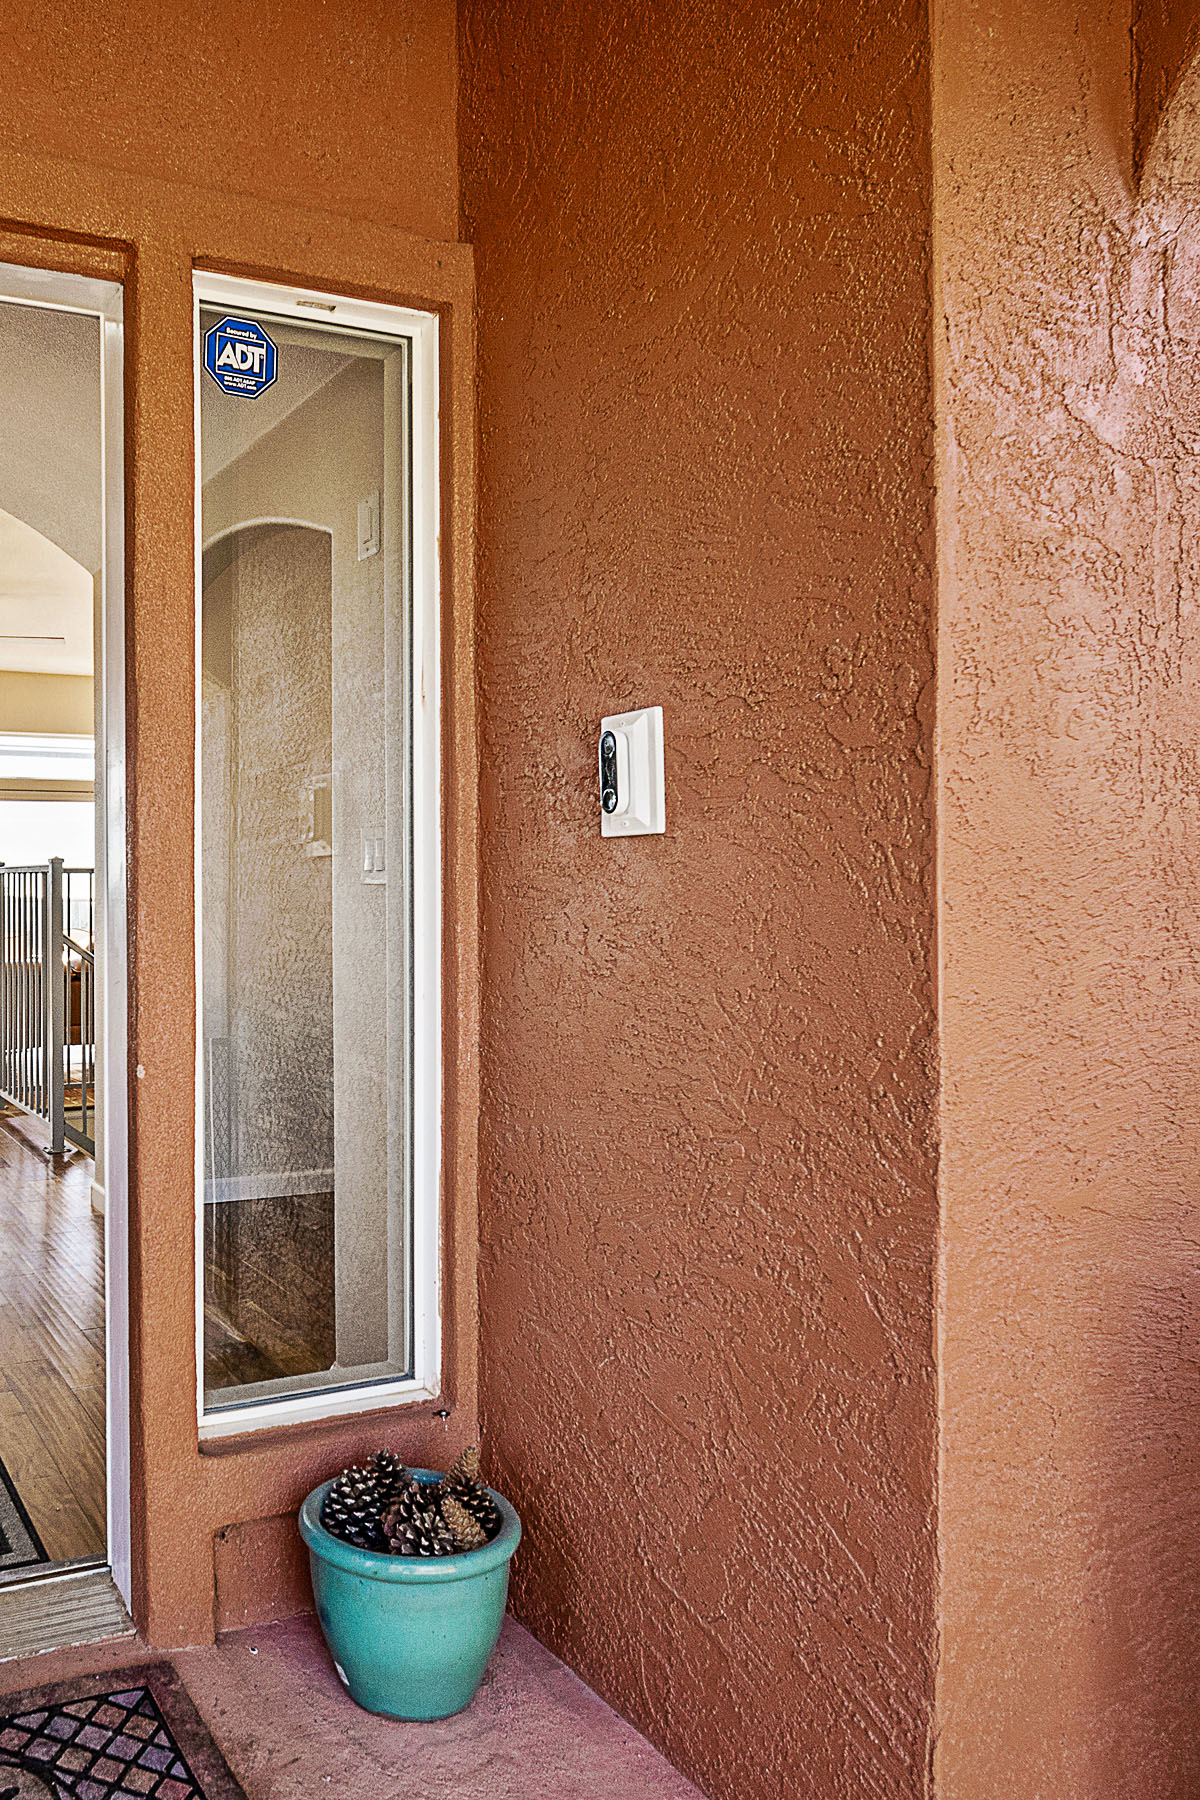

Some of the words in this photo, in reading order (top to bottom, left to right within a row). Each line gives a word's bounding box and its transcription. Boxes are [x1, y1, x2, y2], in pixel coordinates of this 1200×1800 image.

[226, 327, 249, 337] Secured
[250, 331, 258, 340] by
[217, 341, 264, 373] ADT
